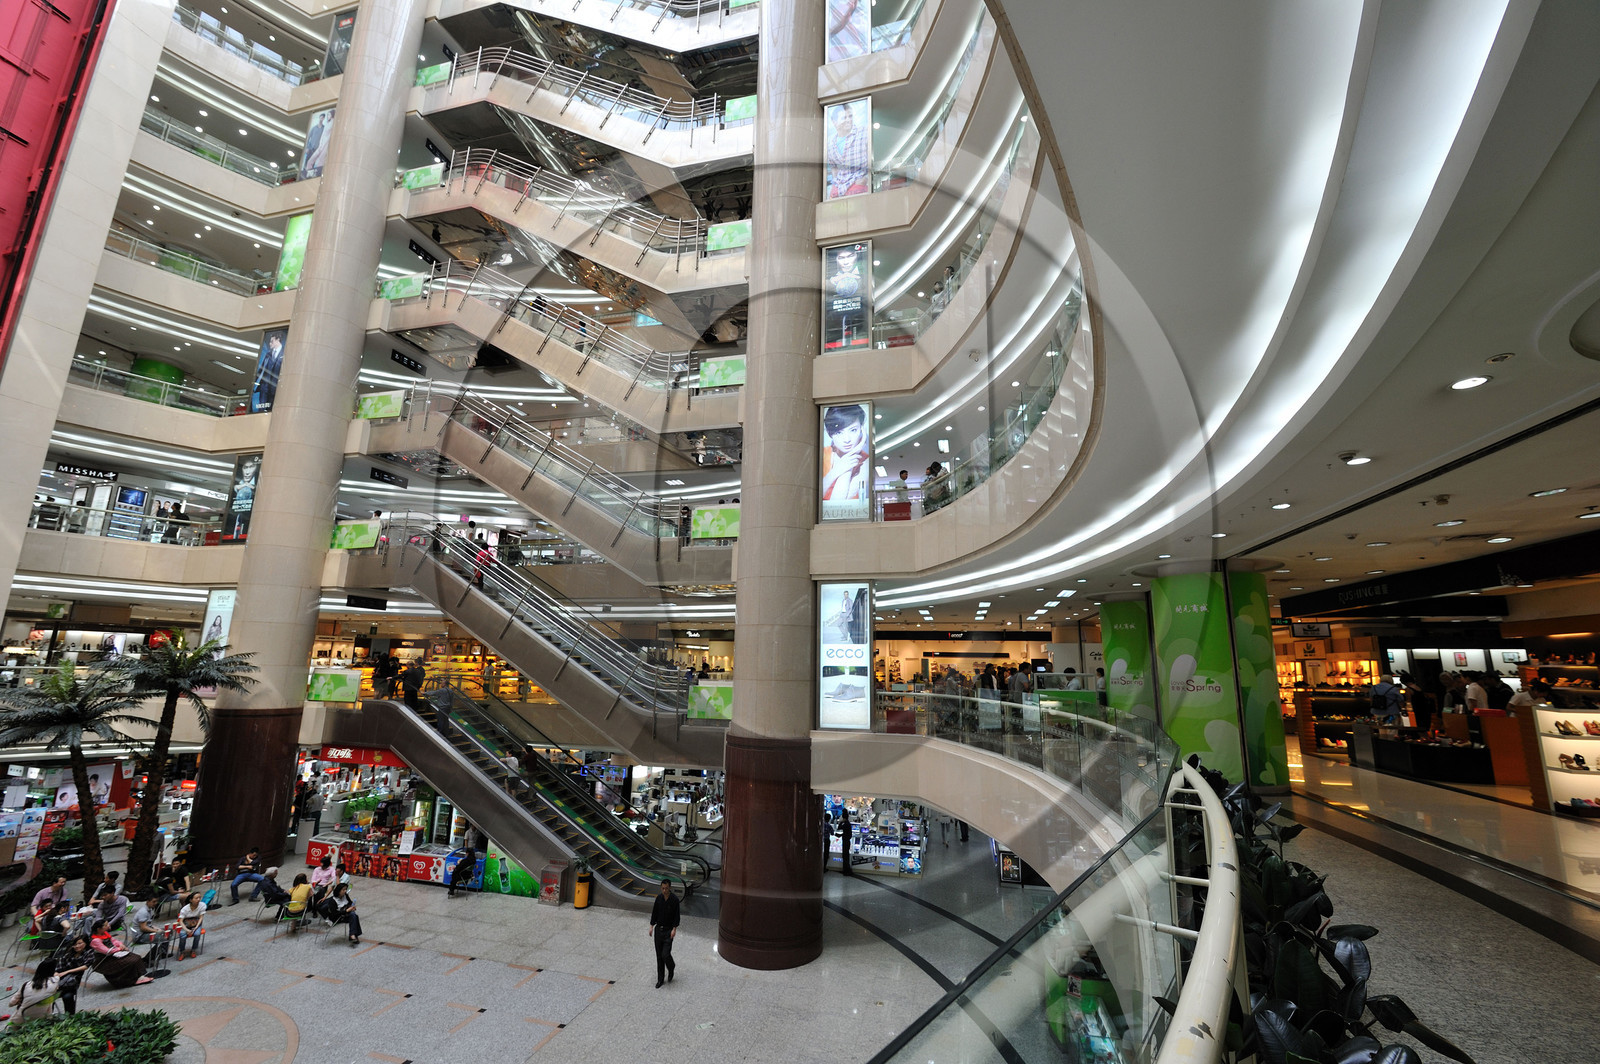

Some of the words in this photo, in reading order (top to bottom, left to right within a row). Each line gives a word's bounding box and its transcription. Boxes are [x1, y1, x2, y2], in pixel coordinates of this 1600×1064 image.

[58, 465, 104, 478] MISSHA
[826, 648, 864, 659] ecco
[1186, 678, 1221, 693] Spring
